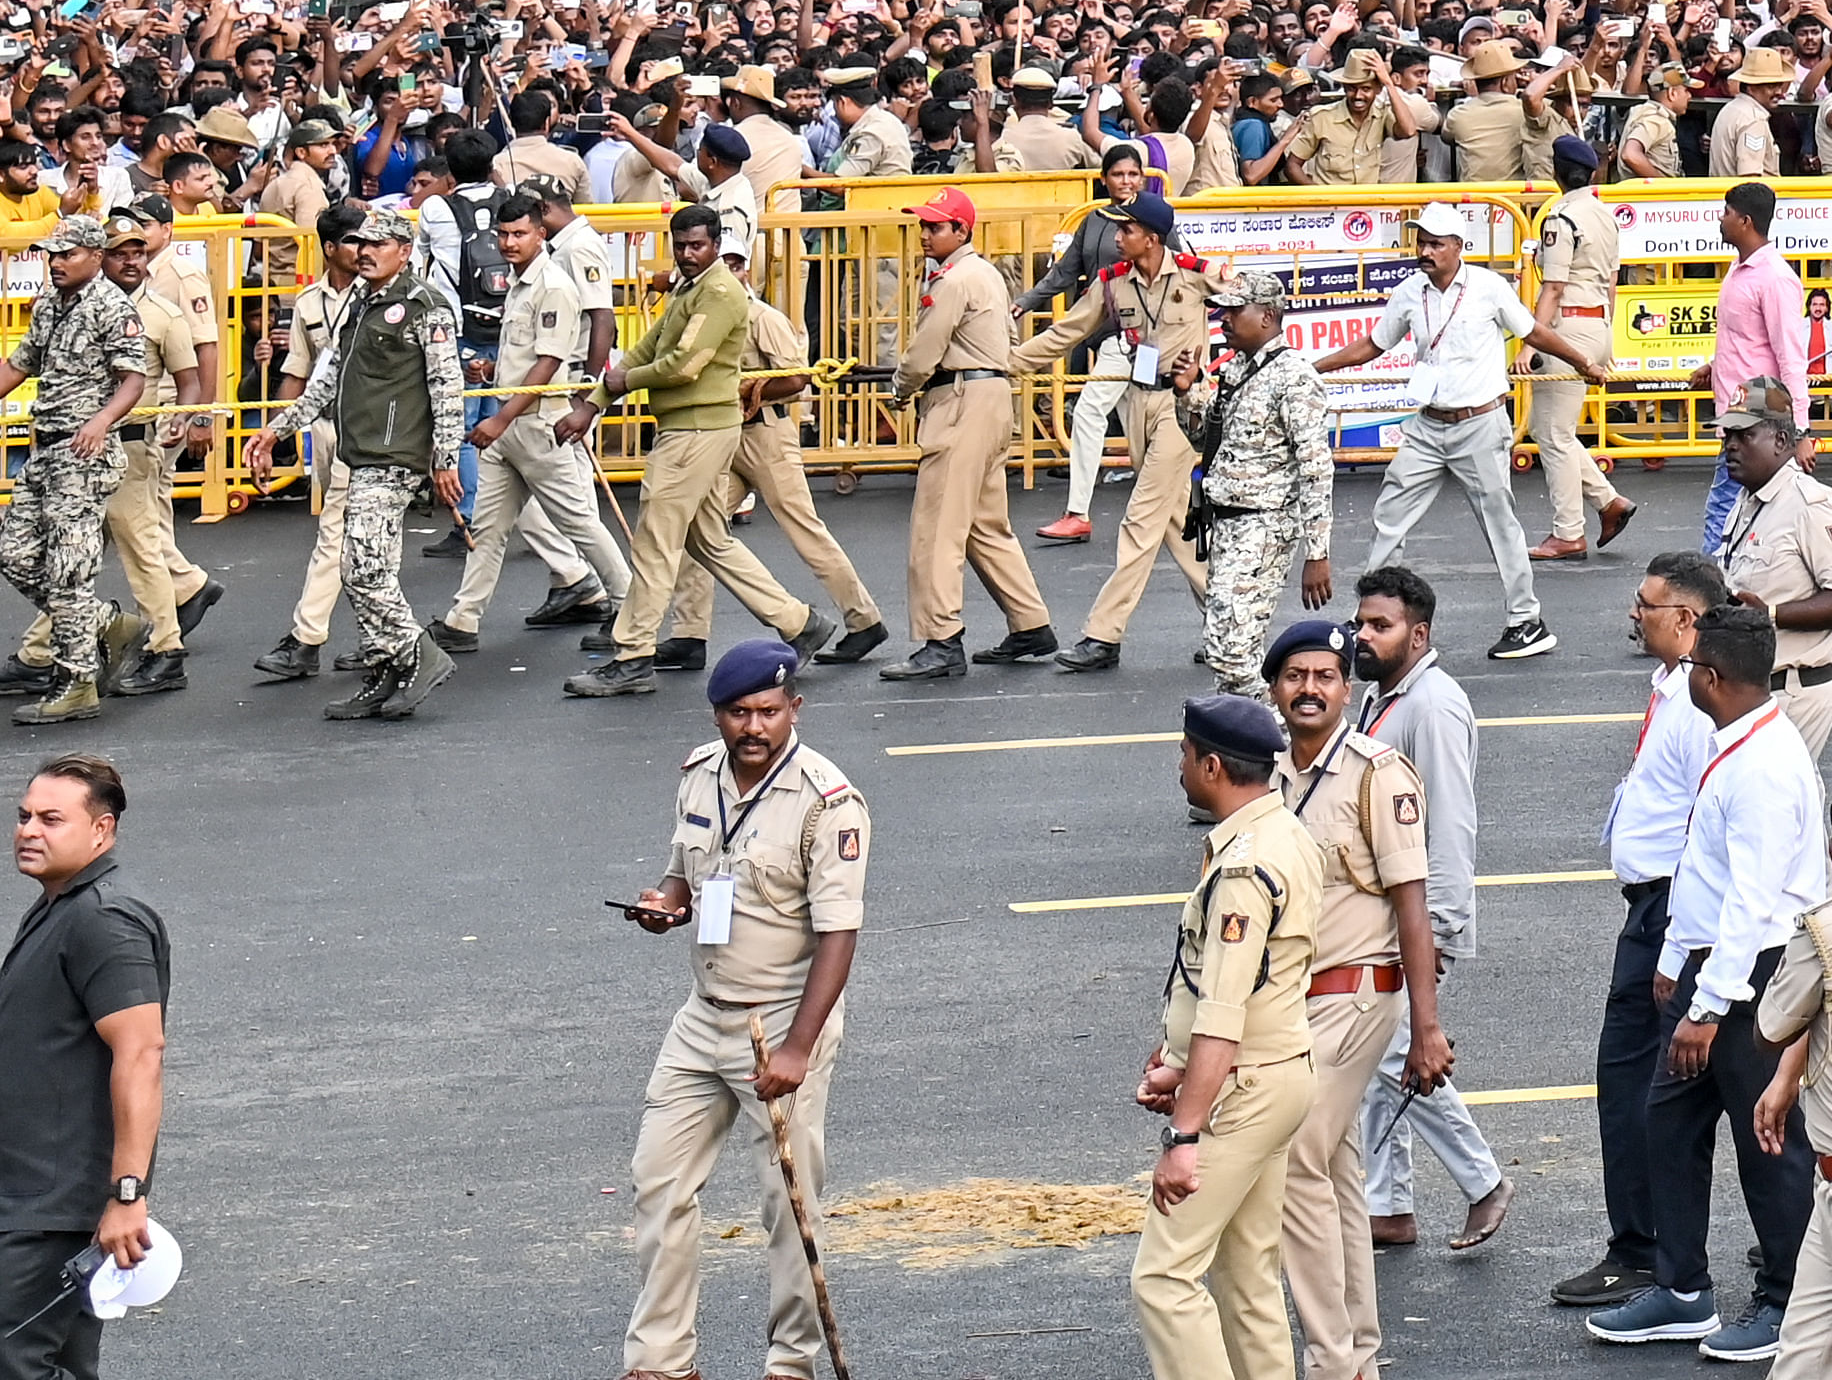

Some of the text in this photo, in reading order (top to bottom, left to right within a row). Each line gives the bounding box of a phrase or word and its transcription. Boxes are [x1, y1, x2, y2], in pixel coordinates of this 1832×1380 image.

[1644, 209, 1700, 223] MYSURU
[1702, 208, 1724, 222] CIT
[1786, 206, 1830, 221] POLICE
[1210, 219, 1237, 234] ನಗರ
[1242, 217, 1283, 233] ಸಂಚಾರ
[1277, 240, 1316, 252] 2024
[1644, 234, 1830, 253] Don't Drin Drive
[1669, 306, 1694, 322] SK
[1286, 323, 1304, 351] O
[1671, 322, 1702, 336] TMT
